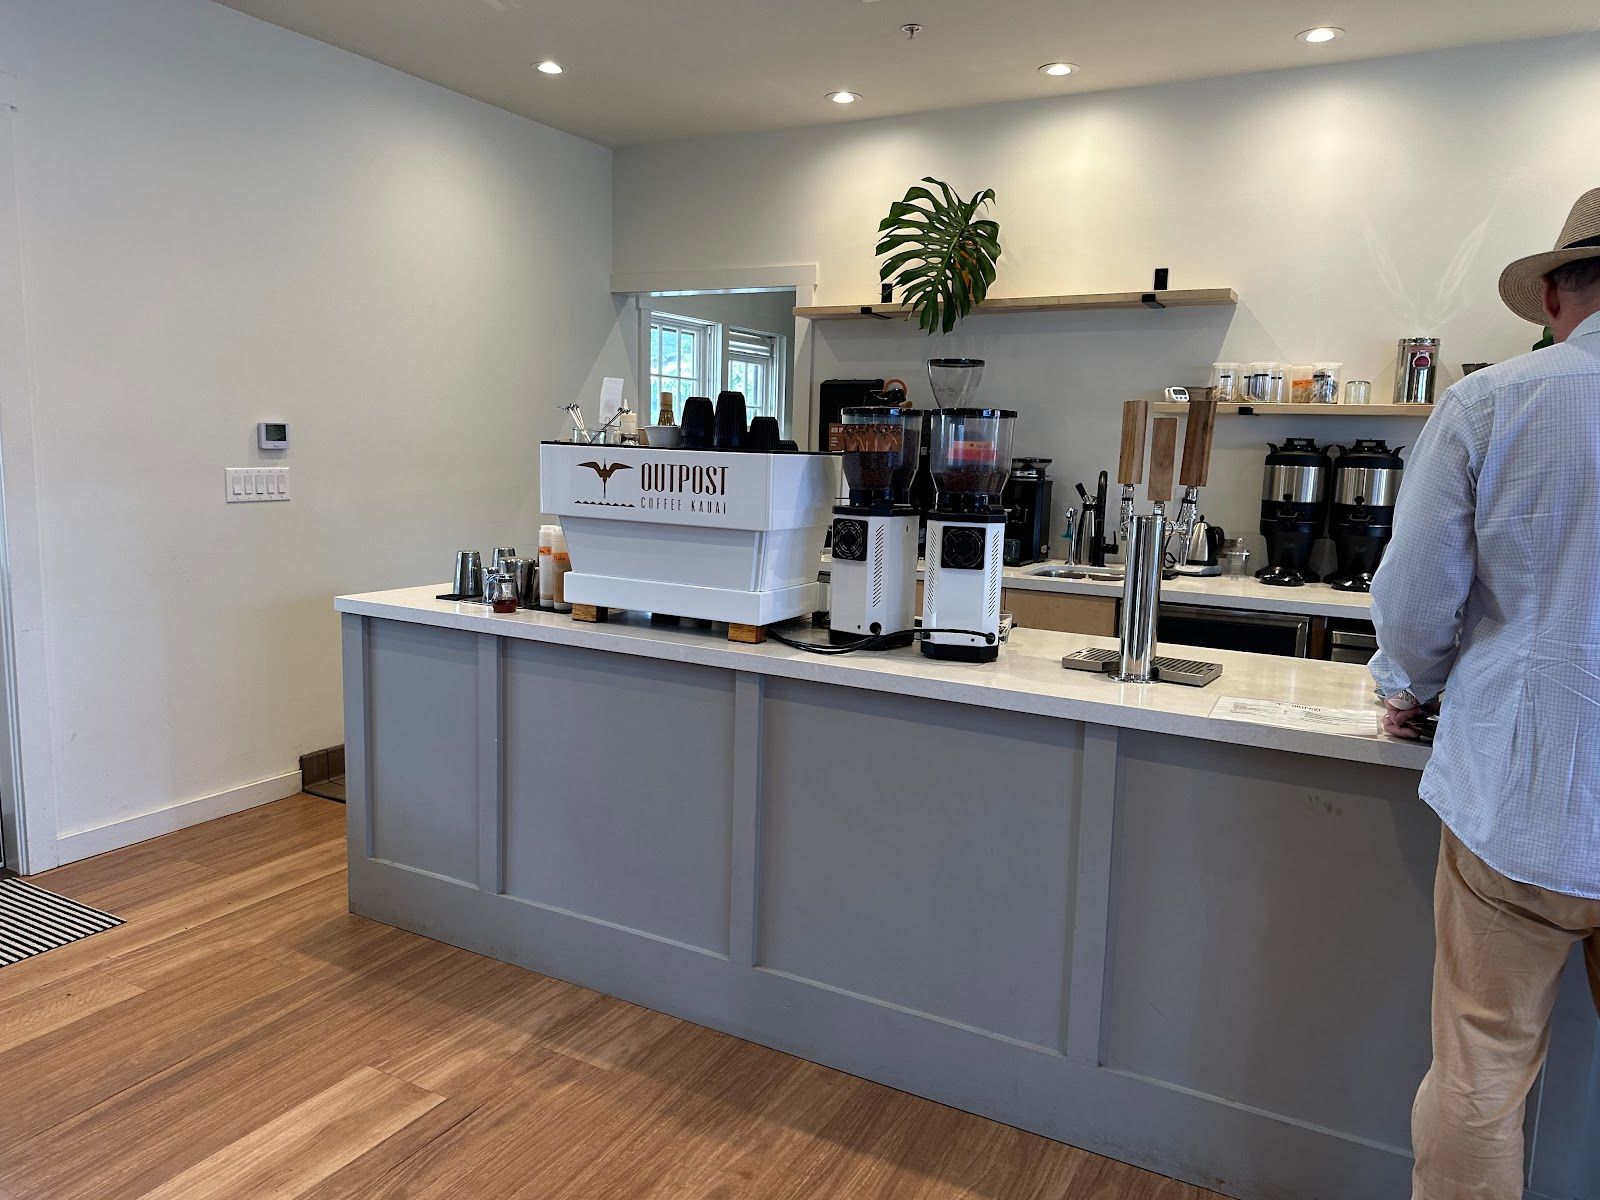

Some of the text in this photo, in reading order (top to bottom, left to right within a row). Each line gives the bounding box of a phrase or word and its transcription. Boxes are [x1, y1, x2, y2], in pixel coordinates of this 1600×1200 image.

[641, 462, 729, 496] OUTPOST
[641, 496, 726, 515] COFFEE KAUAI
